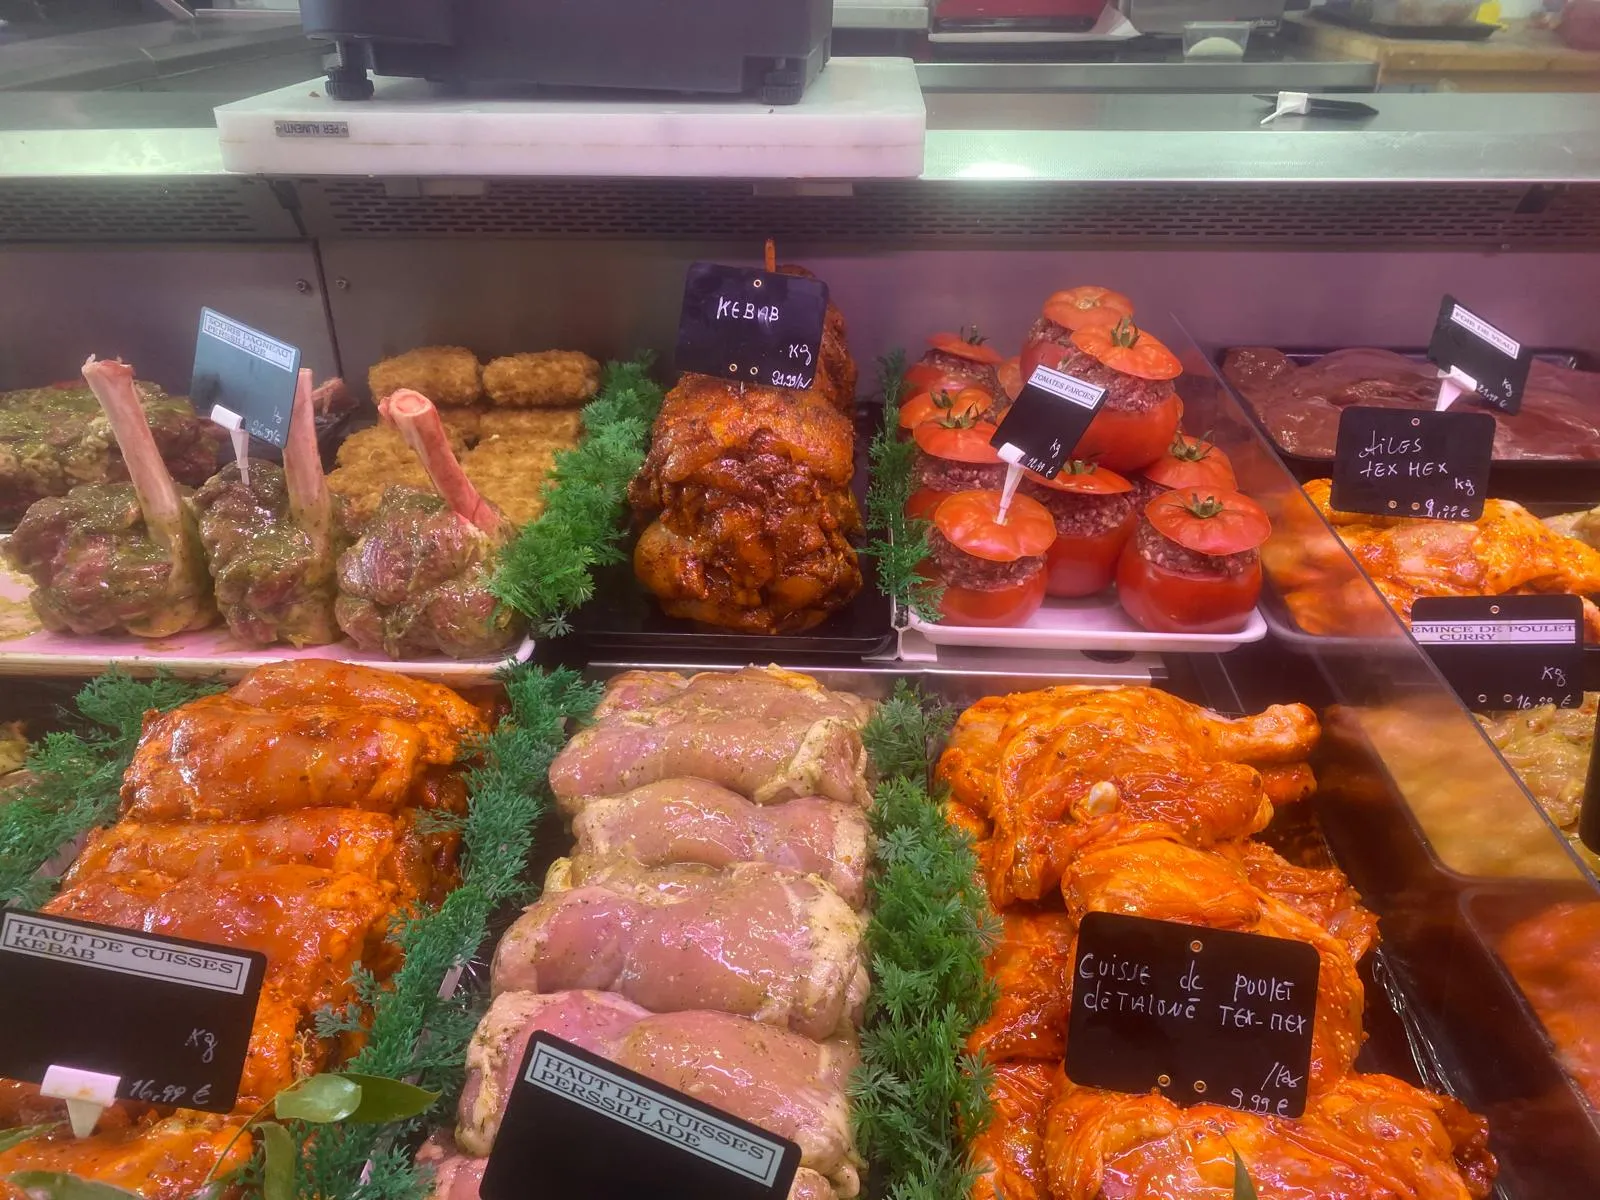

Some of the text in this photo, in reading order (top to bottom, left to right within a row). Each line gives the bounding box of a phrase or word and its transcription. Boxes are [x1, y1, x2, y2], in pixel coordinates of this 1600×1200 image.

[716, 296, 779, 321] KEBAB
[207, 316, 242, 335] SOURIS
[1034, 372, 1096, 402] TOMATES FARCIES
[1411, 624, 1574, 634] EMINCE DE POULET
[1439, 633, 1496, 641] CURRY
[14, 935, 96, 960] KEBAB
[16, 924, 233, 975] HAUT DE CUISSES
[540, 1069, 701, 1147] PERSSILLADE
[545, 1056, 765, 1160] HAUT DE CUISSES
